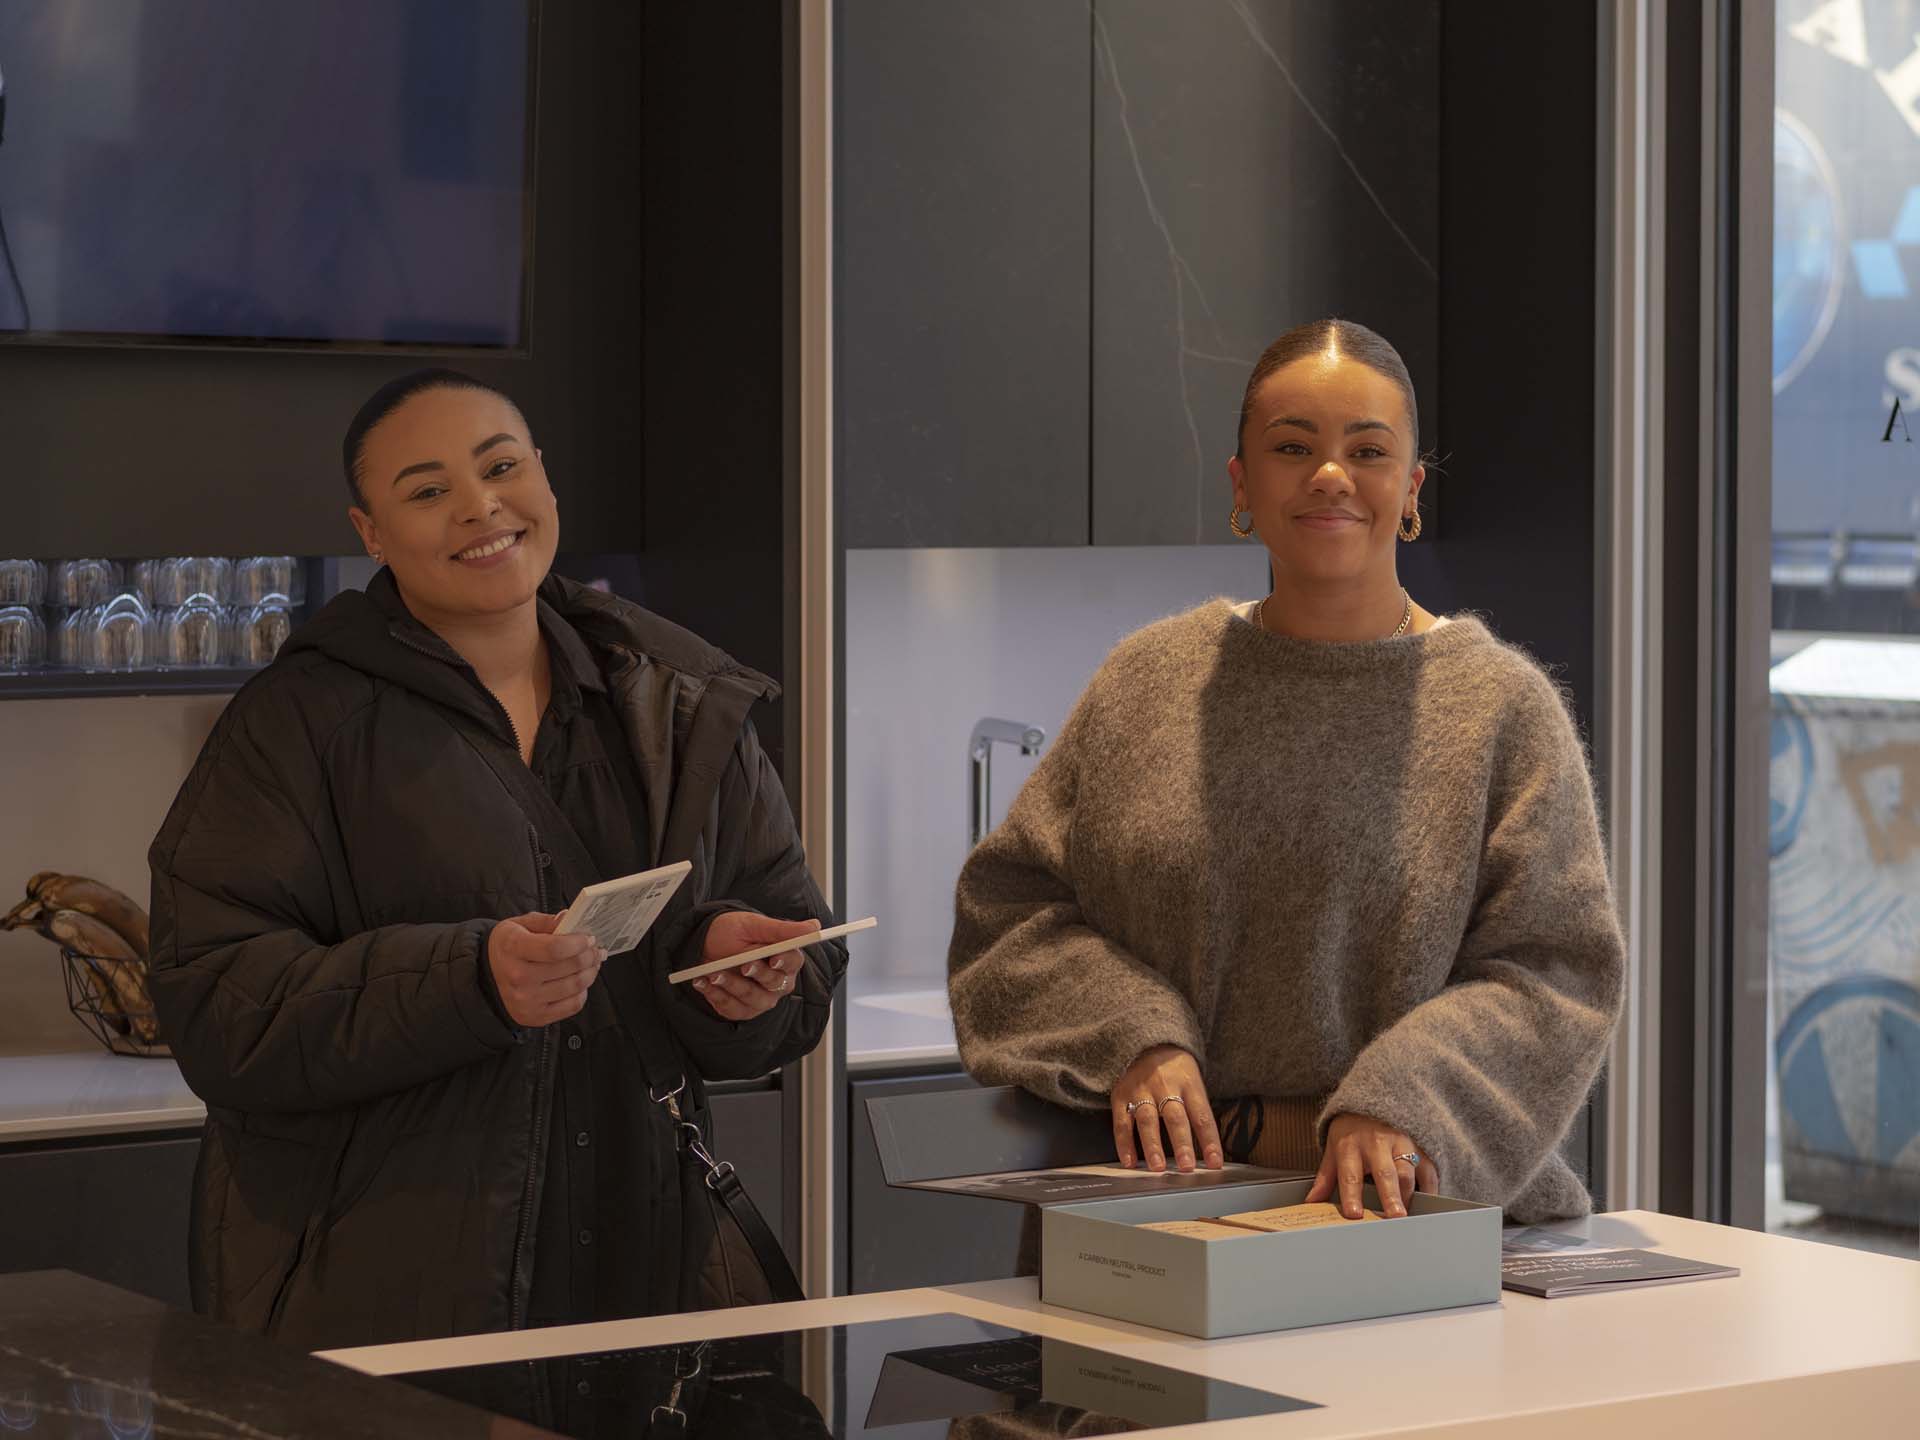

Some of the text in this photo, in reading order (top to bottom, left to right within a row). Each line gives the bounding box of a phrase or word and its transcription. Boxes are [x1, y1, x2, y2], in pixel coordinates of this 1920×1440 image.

[1083, 1253, 1108, 1265] CARBON
[1109, 1258, 1136, 1271] NEUTRAL
[1137, 1263, 1166, 1277] PRODUCT
